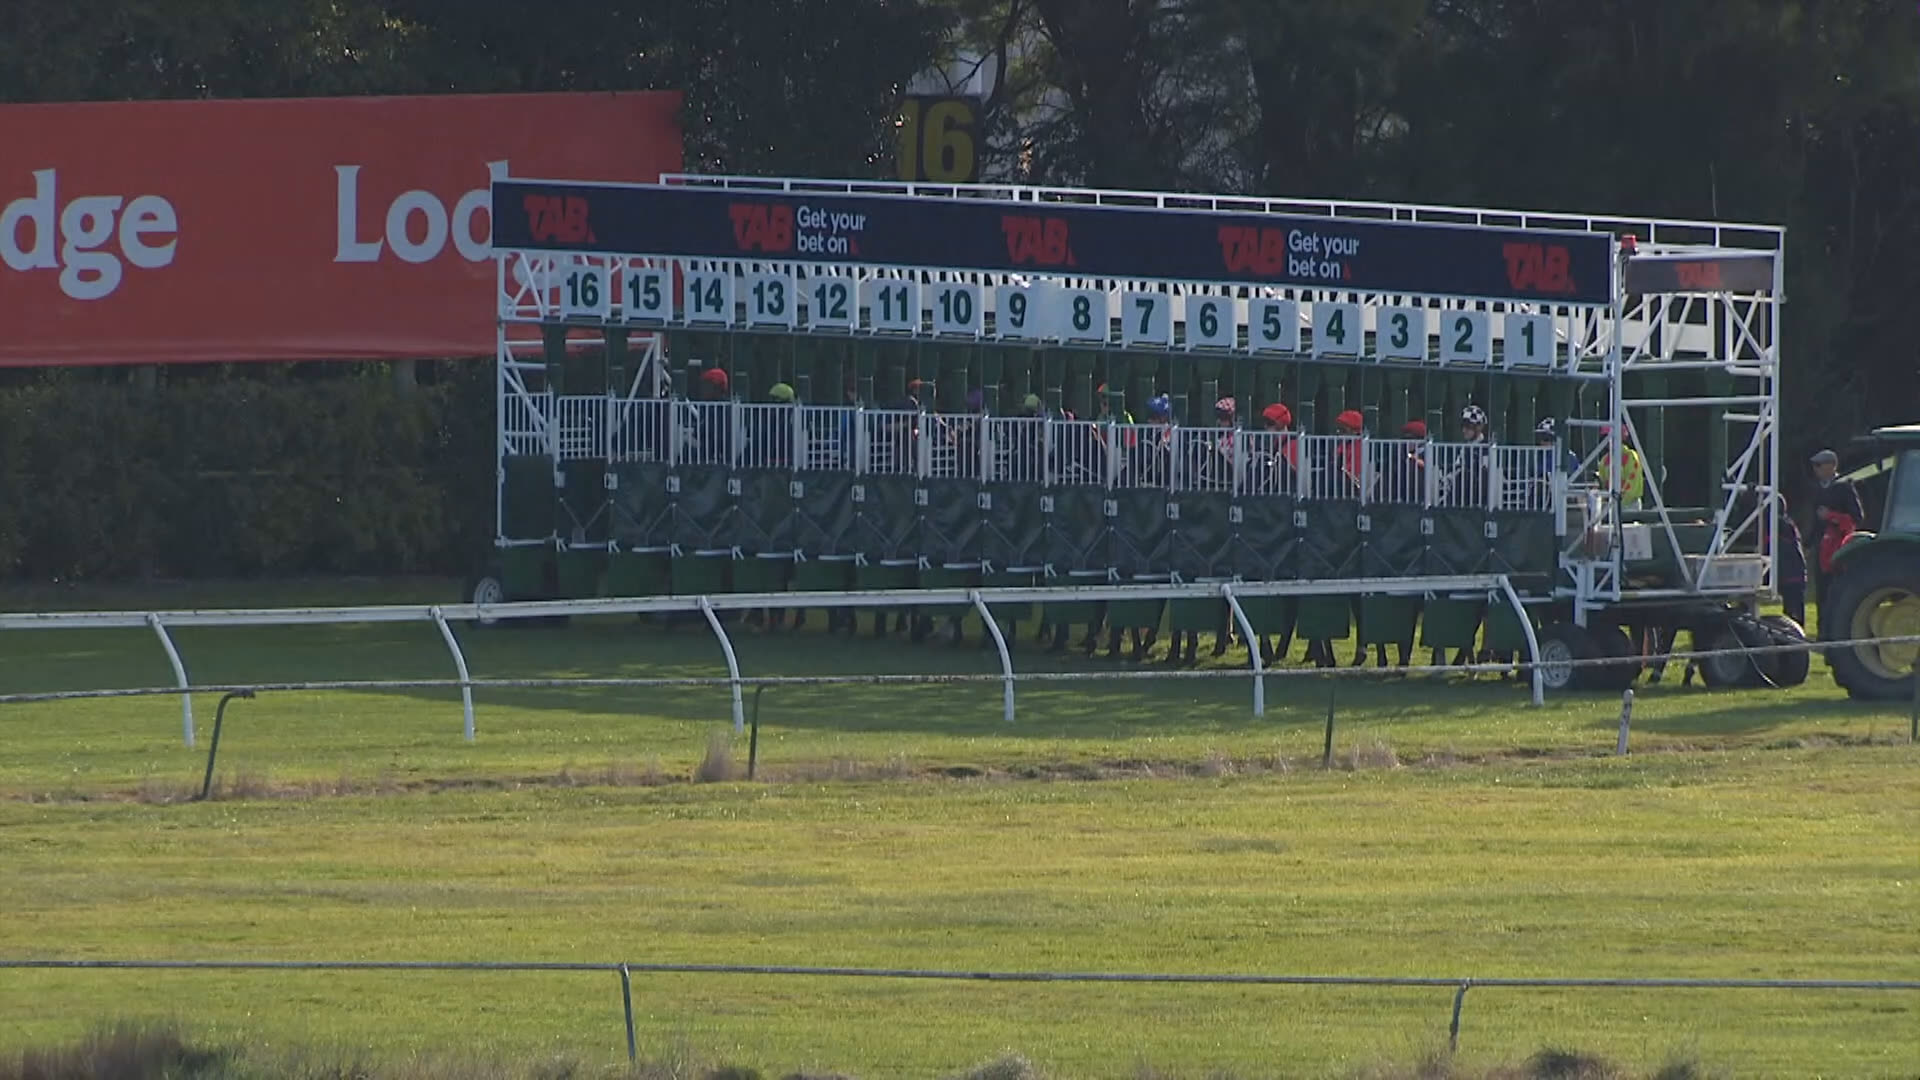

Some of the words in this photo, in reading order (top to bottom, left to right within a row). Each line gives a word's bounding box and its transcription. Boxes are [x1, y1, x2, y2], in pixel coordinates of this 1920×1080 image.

[333, 160, 560, 290] Lod
[797, 206, 827, 228] Get
[830, 211, 866, 235] your
[797, 231, 824, 253] bet
[827, 236, 848, 254] on
[1288, 229, 1319, 253] Get
[1323, 234, 1360, 260] your
[1288, 255, 1316, 278] bet
[1319, 261, 1341, 280] on
[567, 272, 598, 307] 16
[629, 274, 661, 310] 15
[690, 278, 724, 314] 14
[753, 281, 785, 316] 13
[815, 284, 847, 319] 12
[878, 286, 909, 322] 11
[940, 289, 972, 325] 10
[1009, 293, 1027, 328] 9
[1073, 296, 1091, 331] 8
[1135, 298, 1154, 334] 7
[1200, 302, 1218, 338] 6
[1262, 306, 1281, 341] 5
[1326, 310, 1346, 345] 4
[1391, 314, 1409, 349] 3
[1454, 317, 1473, 353] 2
[1521, 320, 1535, 356] 1
